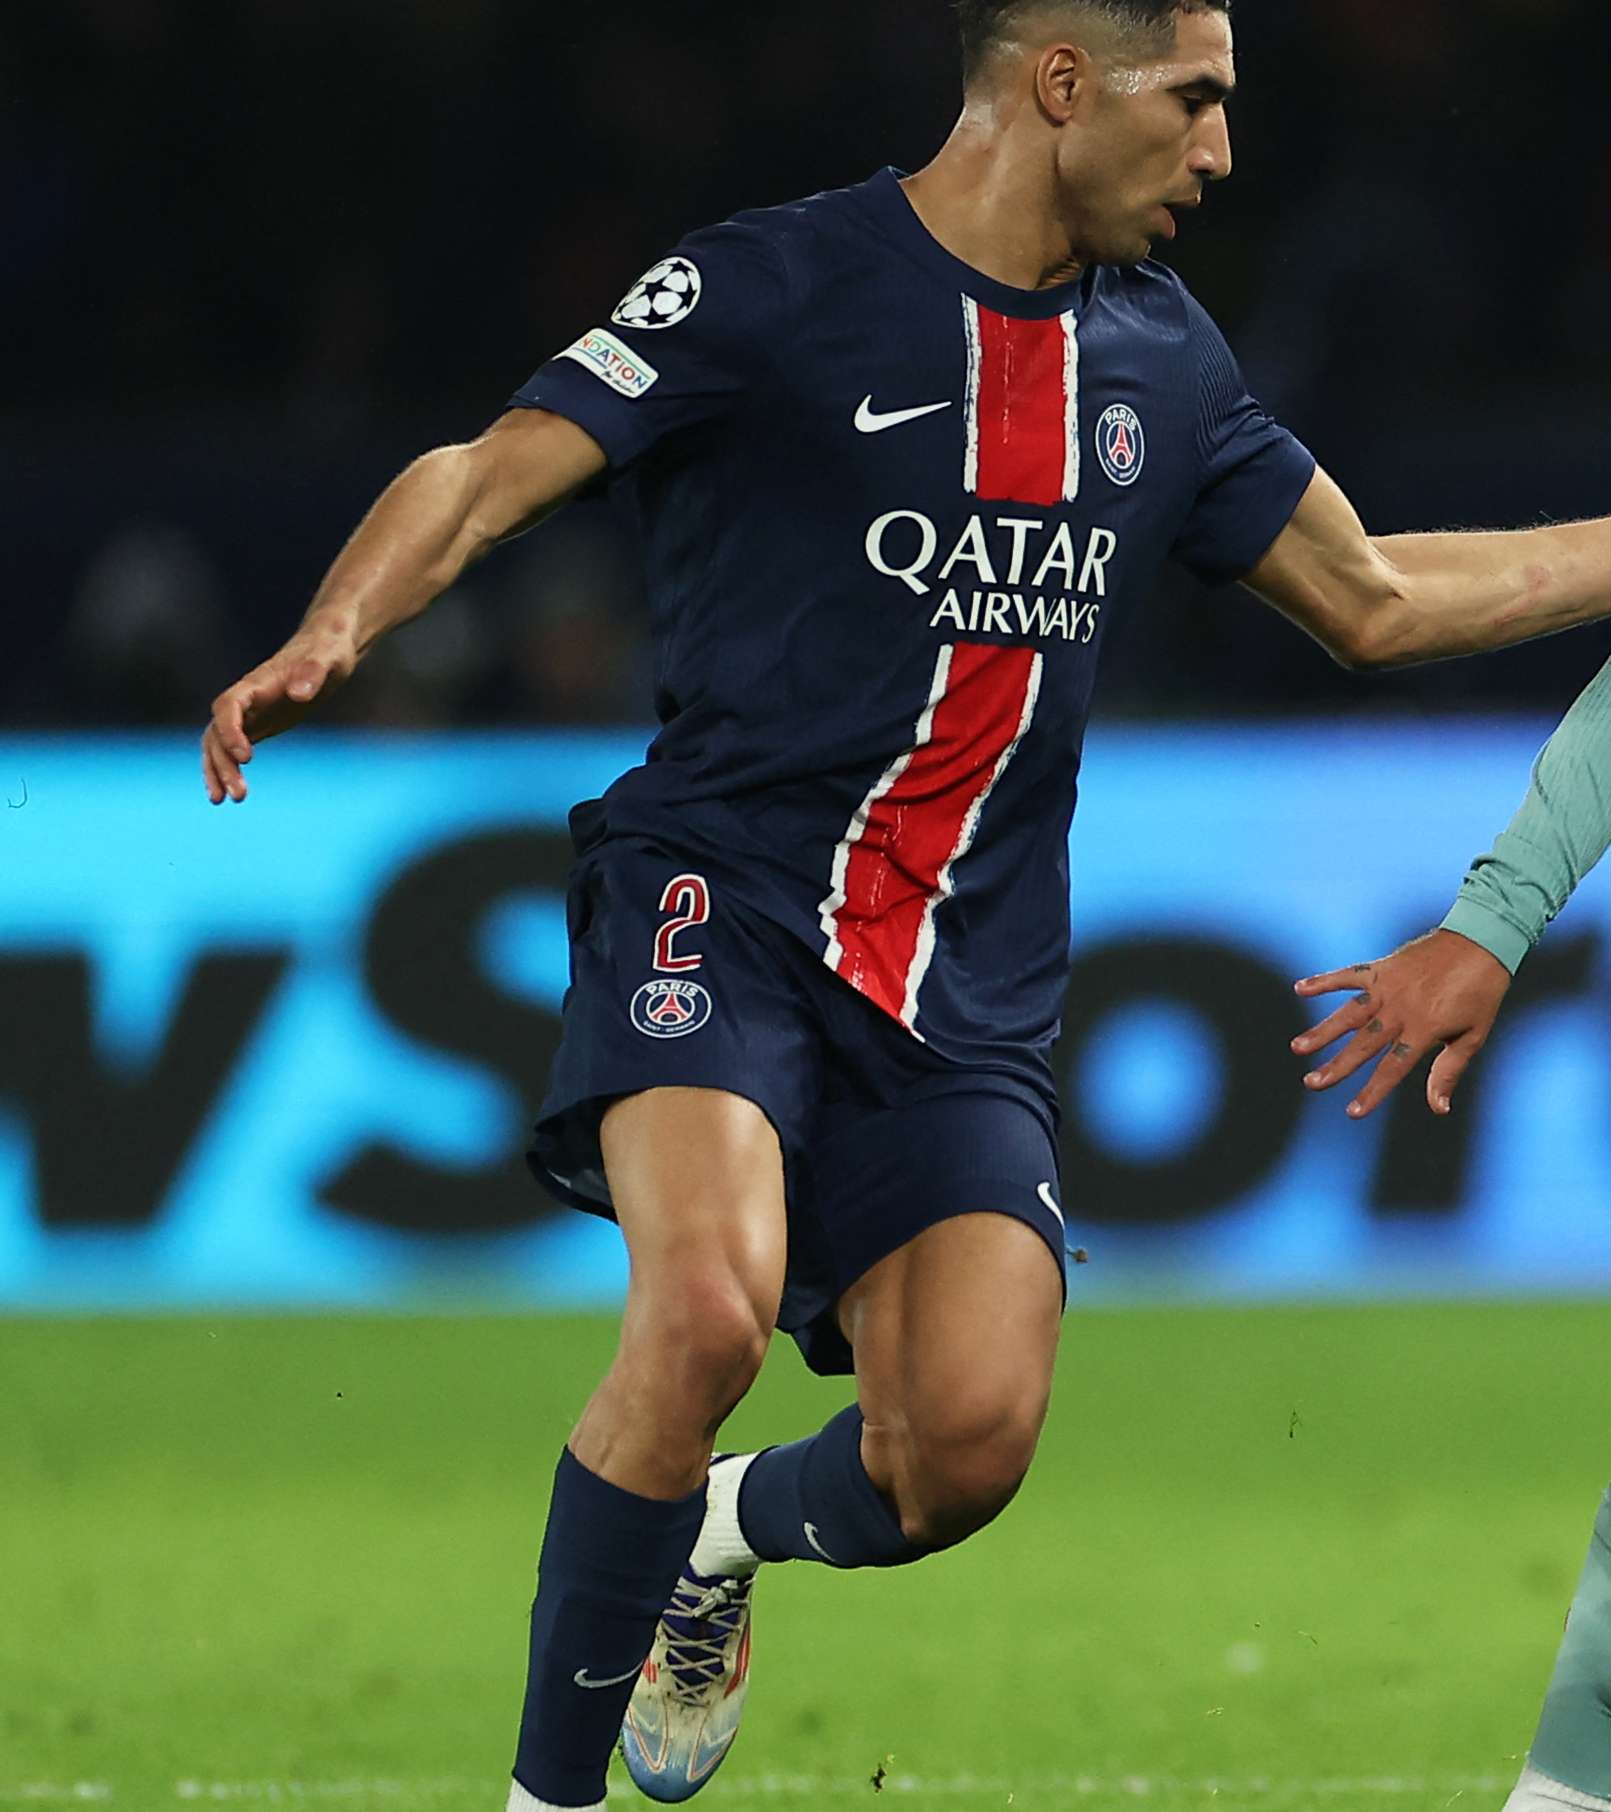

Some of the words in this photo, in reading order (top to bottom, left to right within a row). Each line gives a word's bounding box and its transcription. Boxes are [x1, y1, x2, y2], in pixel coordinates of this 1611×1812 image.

[1105, 408, 1136, 431] PARIS
[865, 510, 1116, 596] QATAR
[929, 588, 1099, 643] AIRWAYS
[653, 873, 710, 973] 2
[646, 982, 699, 997] PARIS
